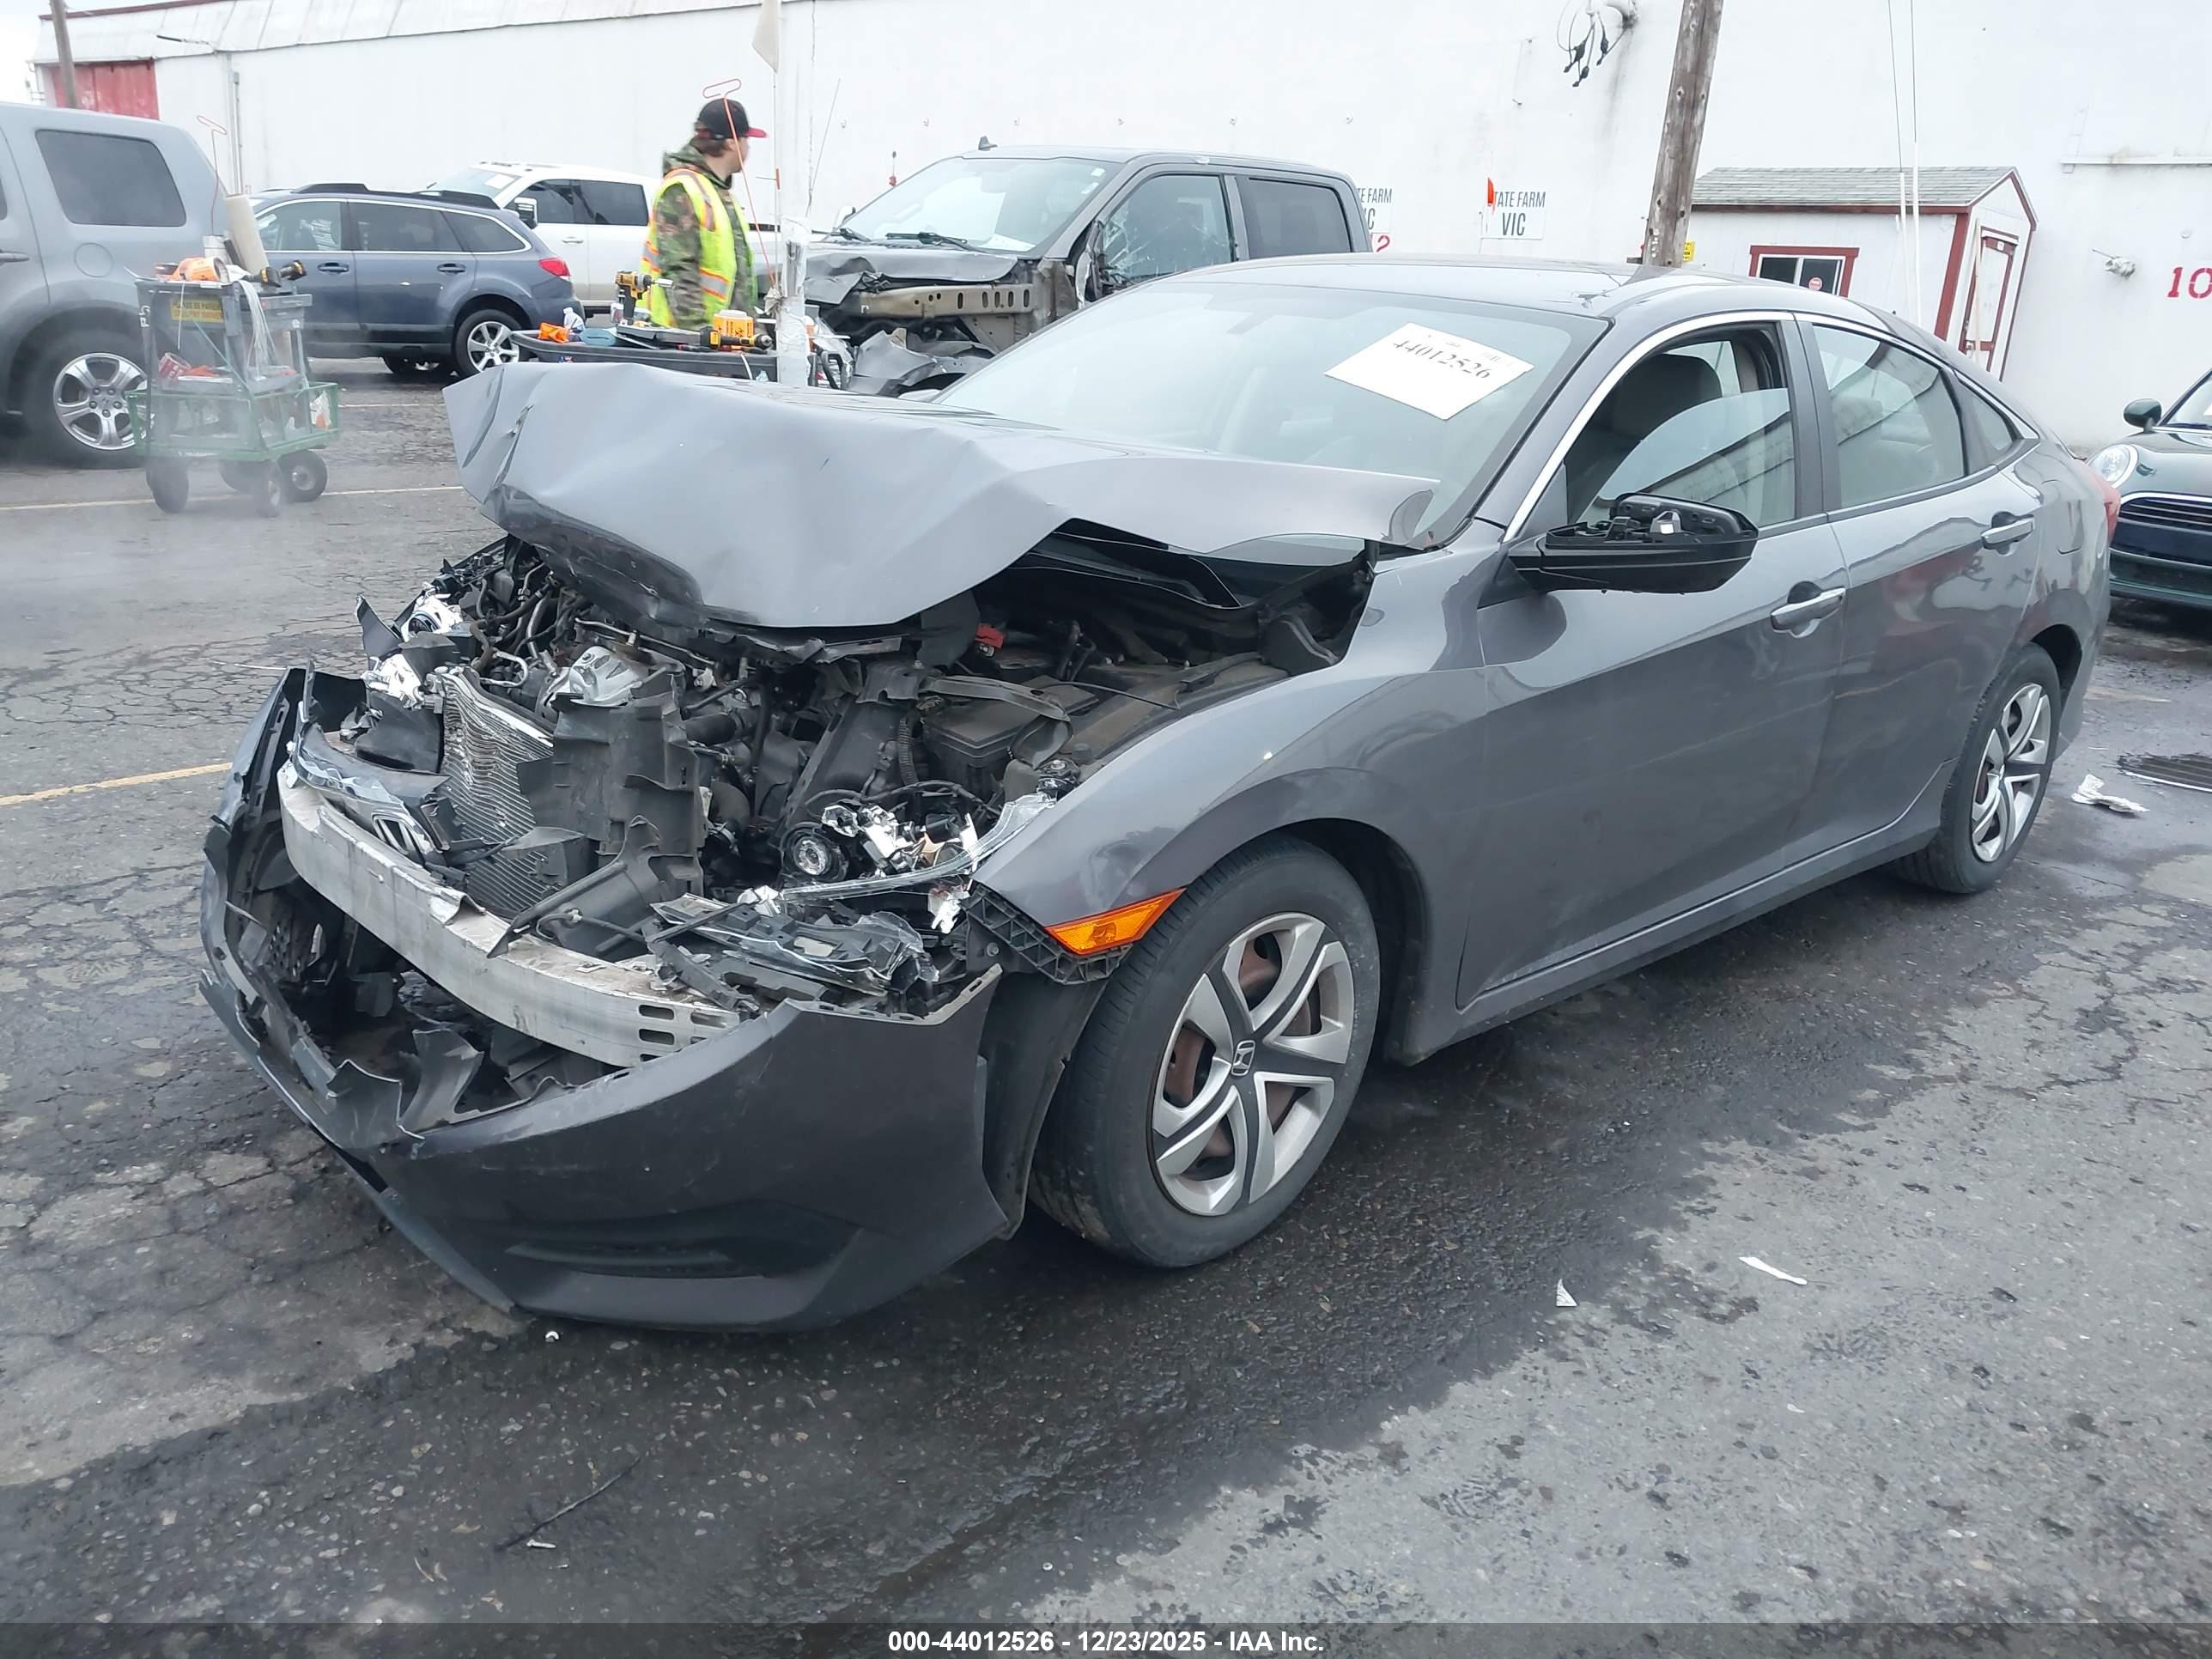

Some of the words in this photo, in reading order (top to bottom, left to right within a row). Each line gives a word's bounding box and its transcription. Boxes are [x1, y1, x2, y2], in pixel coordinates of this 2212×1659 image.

[1367, 188, 1392, 204] FARM
[1492, 191, 1516, 208] TATE
[1516, 191, 1547, 208] FARM
[1502, 212, 1526, 236] VIC
[1393, 340, 1491, 379] 44012526
